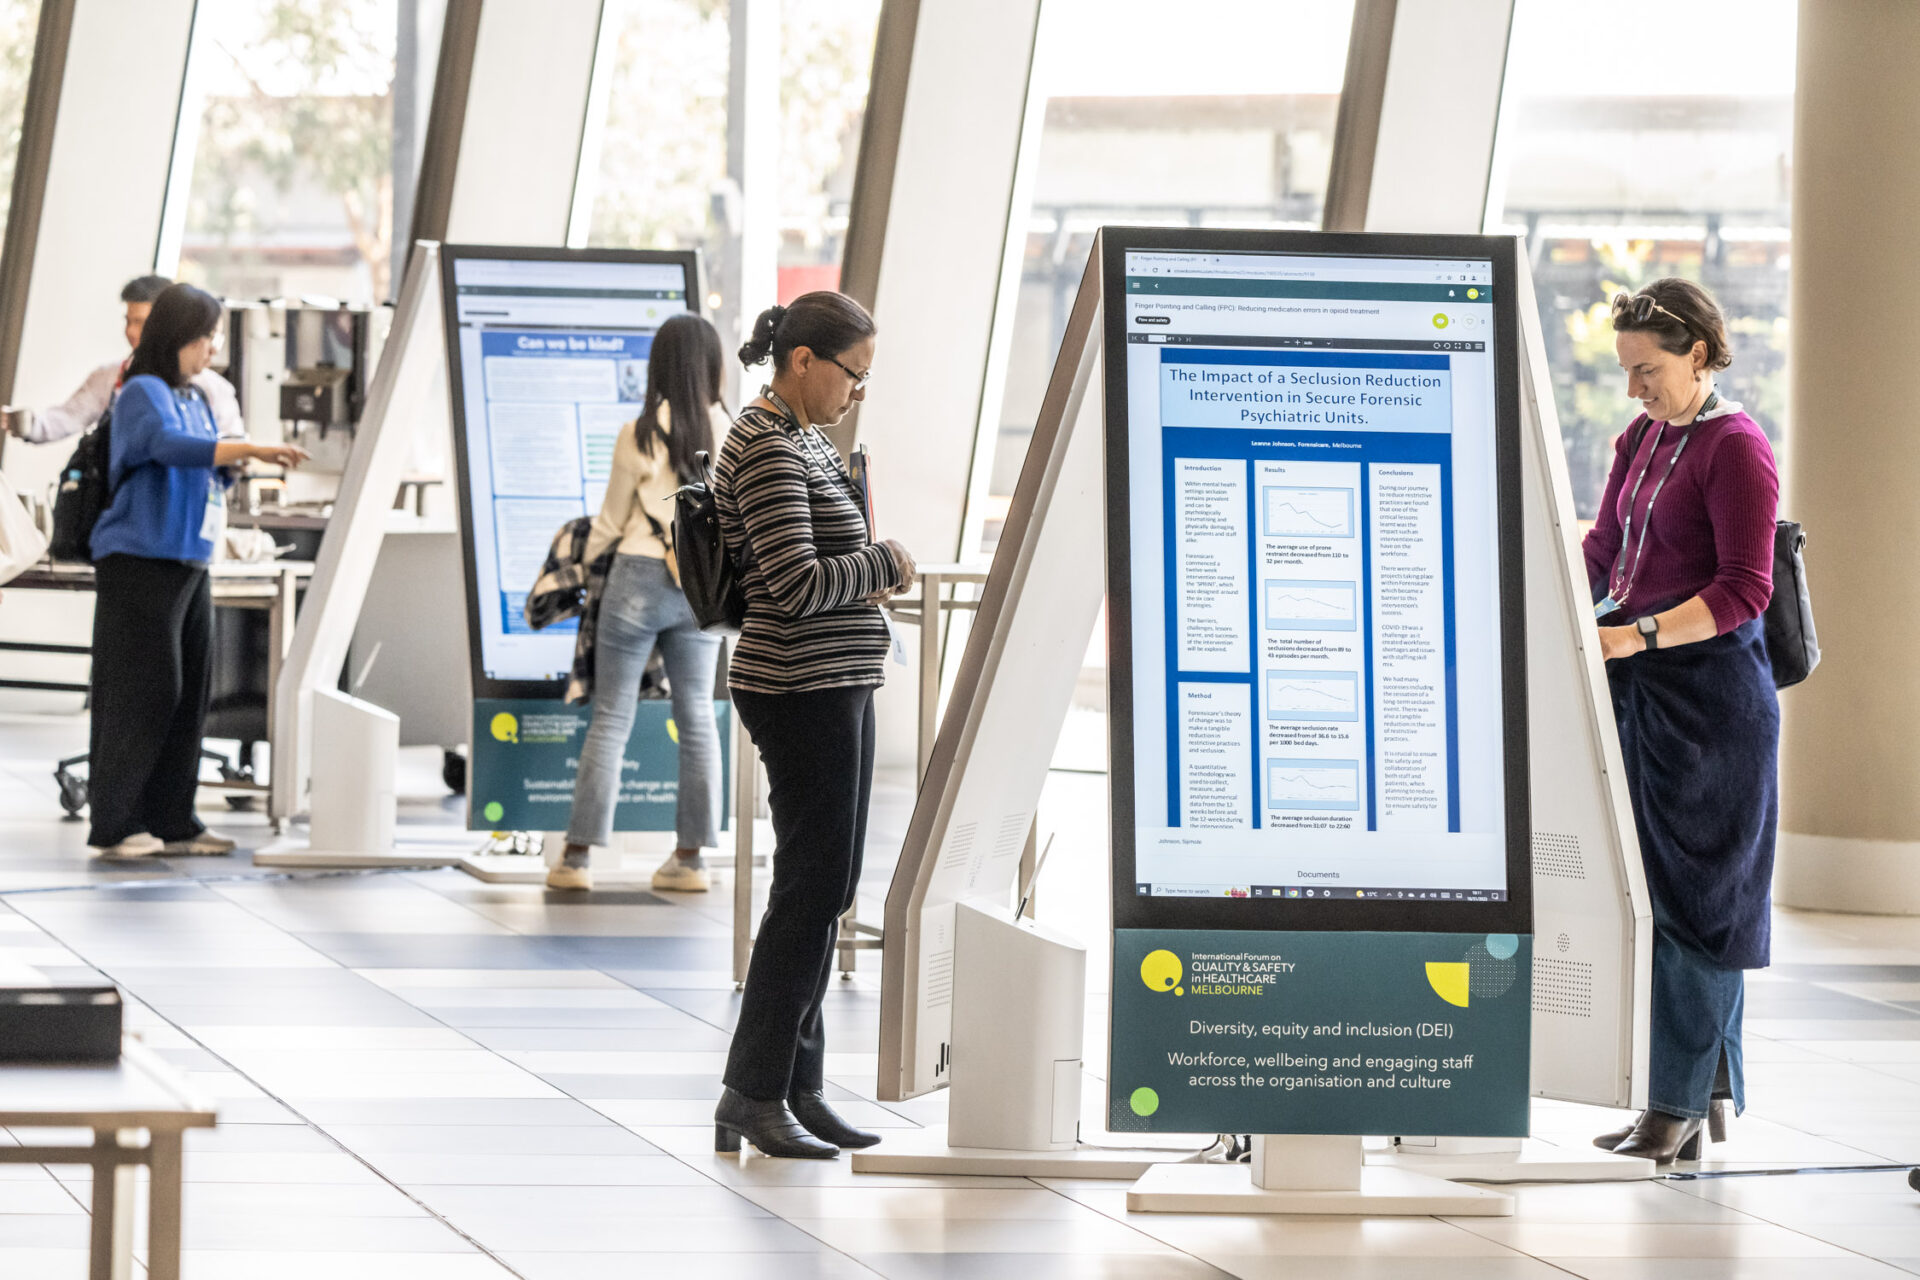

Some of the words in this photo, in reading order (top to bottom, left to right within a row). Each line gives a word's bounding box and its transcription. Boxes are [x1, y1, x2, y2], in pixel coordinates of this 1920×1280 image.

[1134, 302, 1154, 310] Finger
[1155, 302, 1181, 310] Pointing
[1194, 303, 1216, 312] Calling
[1237, 304, 1266, 313] Reducing
[518, 336, 545, 350] Can
[546, 339, 567, 351] we
[568, 337, 587, 351] be
[588, 337, 625, 352] kind?
[1169, 368, 1196, 381] The
[1202, 369, 1253, 384] Impact
[1257, 370, 1272, 383] of
[1277, 374, 1285, 384] a
[1290, 371, 1360, 386] Seclusion
[1365, 373, 1440, 387] Reduction
[1189, 388, 1282, 402] Intervention
[1287, 390, 1300, 403] in
[1305, 391, 1355, 404] Secure
[1360, 392, 1422, 406] Forensic
[1240, 408, 1320, 426] Psychiatric
[1325, 410, 1368, 424] Units.
[1297, 870, 1339, 878] Documents
[1165, 887, 1176, 895] Type
[1192, 952, 1243, 961] International
[1244, 952, 1270, 961] Forum
[1192, 961, 1242, 972] QUALITY
[1242, 962, 1251, 972] &
[1252, 962, 1295, 973] SAFETY
[1192, 973, 1201, 983] in
[1203, 973, 1276, 984] HEALTHCARE
[1191, 984, 1263, 995] MELBOURNE
[1190, 1020, 1257, 1039] Diversity,
[1262, 1022, 1309, 1039] equity
[1313, 1021, 1341, 1036] and
[1346, 1022, 1412, 1037] inclusion
[1416, 1023, 1453, 1039] (DEI)
[1167, 1051, 1249, 1068] Workforce,
[1254, 1052, 1328, 1071] wellbeing
[1332, 1053, 1361, 1068] and
[1365, 1055, 1437, 1072] engaging
[1442, 1054, 1474, 1069] staff
[1189, 1076, 1236, 1087] across
[1240, 1072, 1265, 1087] the
[1269, 1073, 1362, 1092] organisation
[1367, 1073, 1395, 1088] and
[1400, 1074, 1451, 1089] culture
